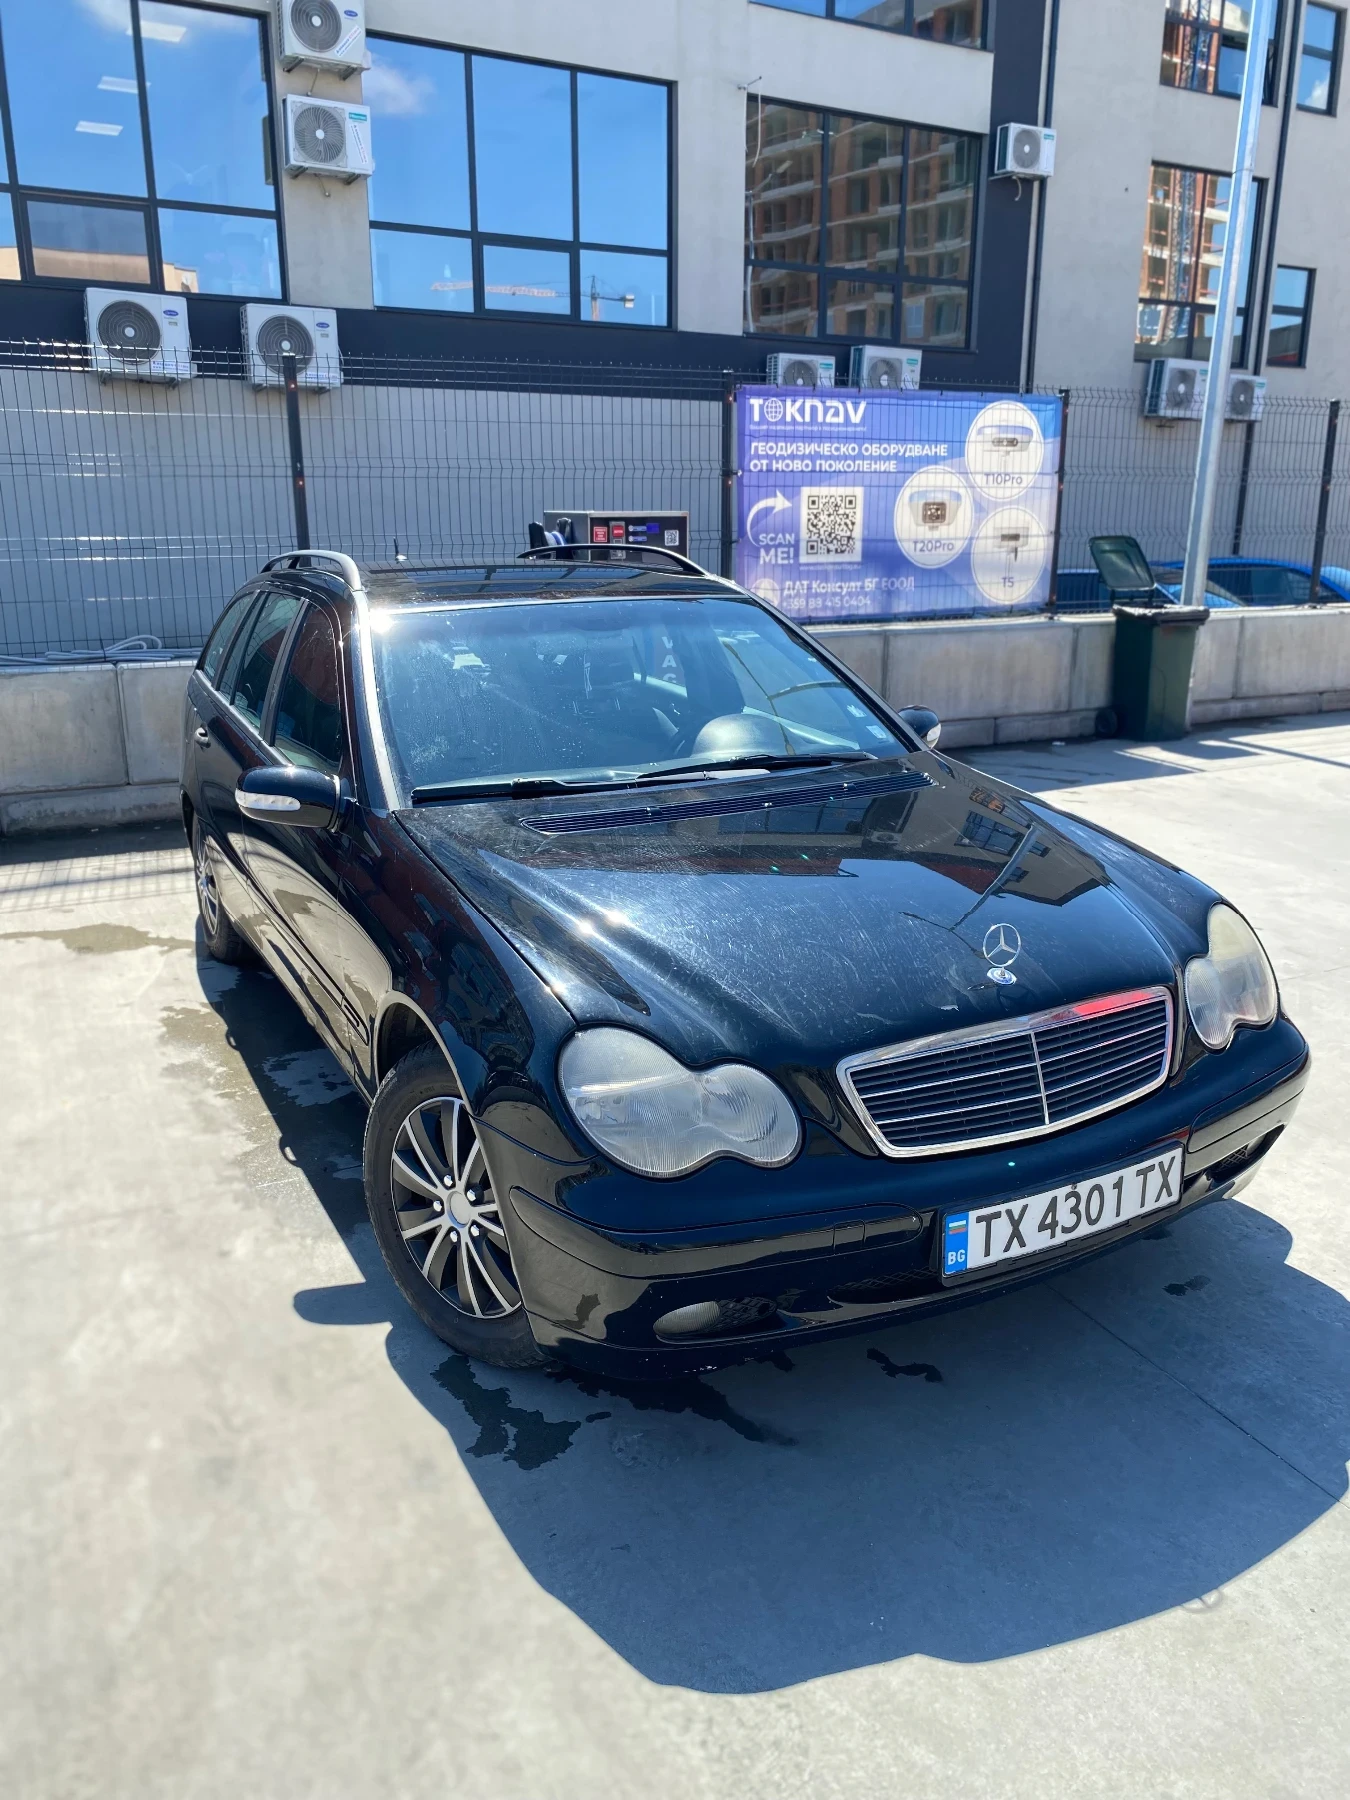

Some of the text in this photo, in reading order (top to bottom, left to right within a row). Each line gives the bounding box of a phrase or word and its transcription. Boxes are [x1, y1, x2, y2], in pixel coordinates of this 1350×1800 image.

[750, 442, 948, 458] ГЕОДИЗИЧЕСКО ОБОРУДВАНЕ
[750, 460, 898, 472] ОТ НОВО ПОКОЛЕНИЕ
[984, 473, 1023, 486] T10Pro
[758, 532, 795, 545] SCAN
[912, 540, 955, 553] T20Pro
[759, 547, 794, 565] ME!
[812, 579, 862, 596] Консулт
[864, 577, 879, 592] БГ
[881, 576, 915, 592] ЕООД
[1002, 576, 1015, 589] T5
[975, 1155, 1176, 1258] TX 4301 TX
[947, 1249, 966, 1266] BG
